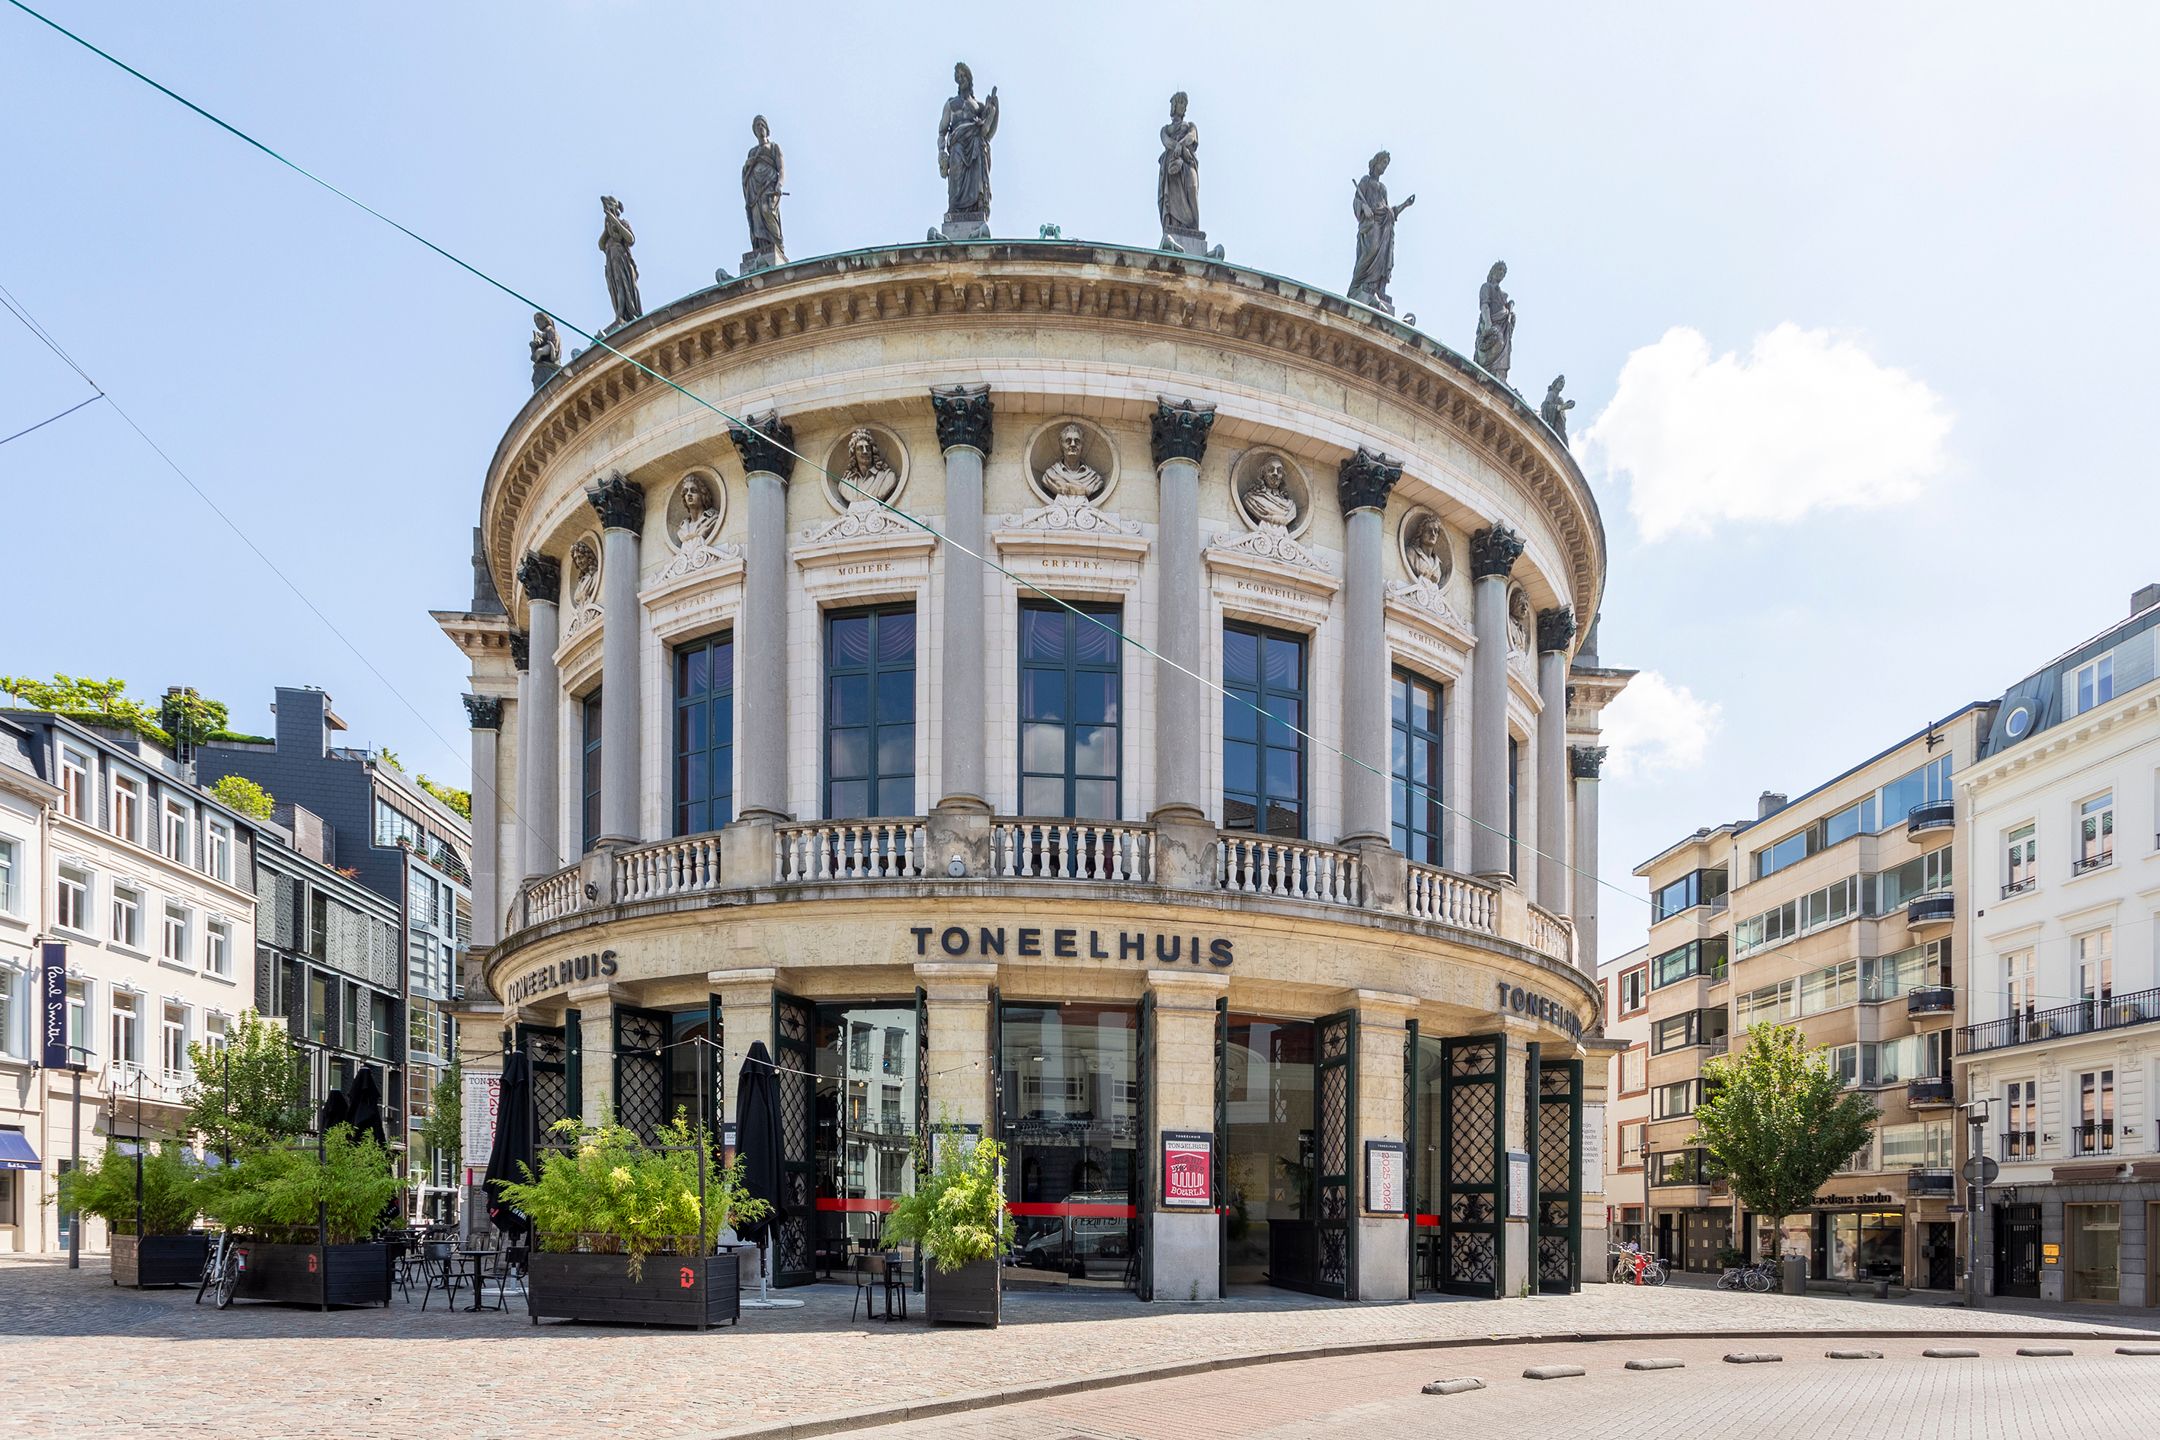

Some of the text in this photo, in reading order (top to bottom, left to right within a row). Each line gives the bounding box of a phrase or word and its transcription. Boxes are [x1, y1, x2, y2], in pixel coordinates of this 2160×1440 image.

[838, 563, 895, 576] MOLIERE.
[1042, 559, 1102, 569] GRETRY.
[910, 926, 1234, 967] TONEELHUIS
[508, 949, 618, 1006] TONEELHUIS
[47, 965, 65, 1047] Paul Smith
[1381, 1152, 1392, 1211] 2025 2026
[1856, 1192, 1892, 1204] studio
